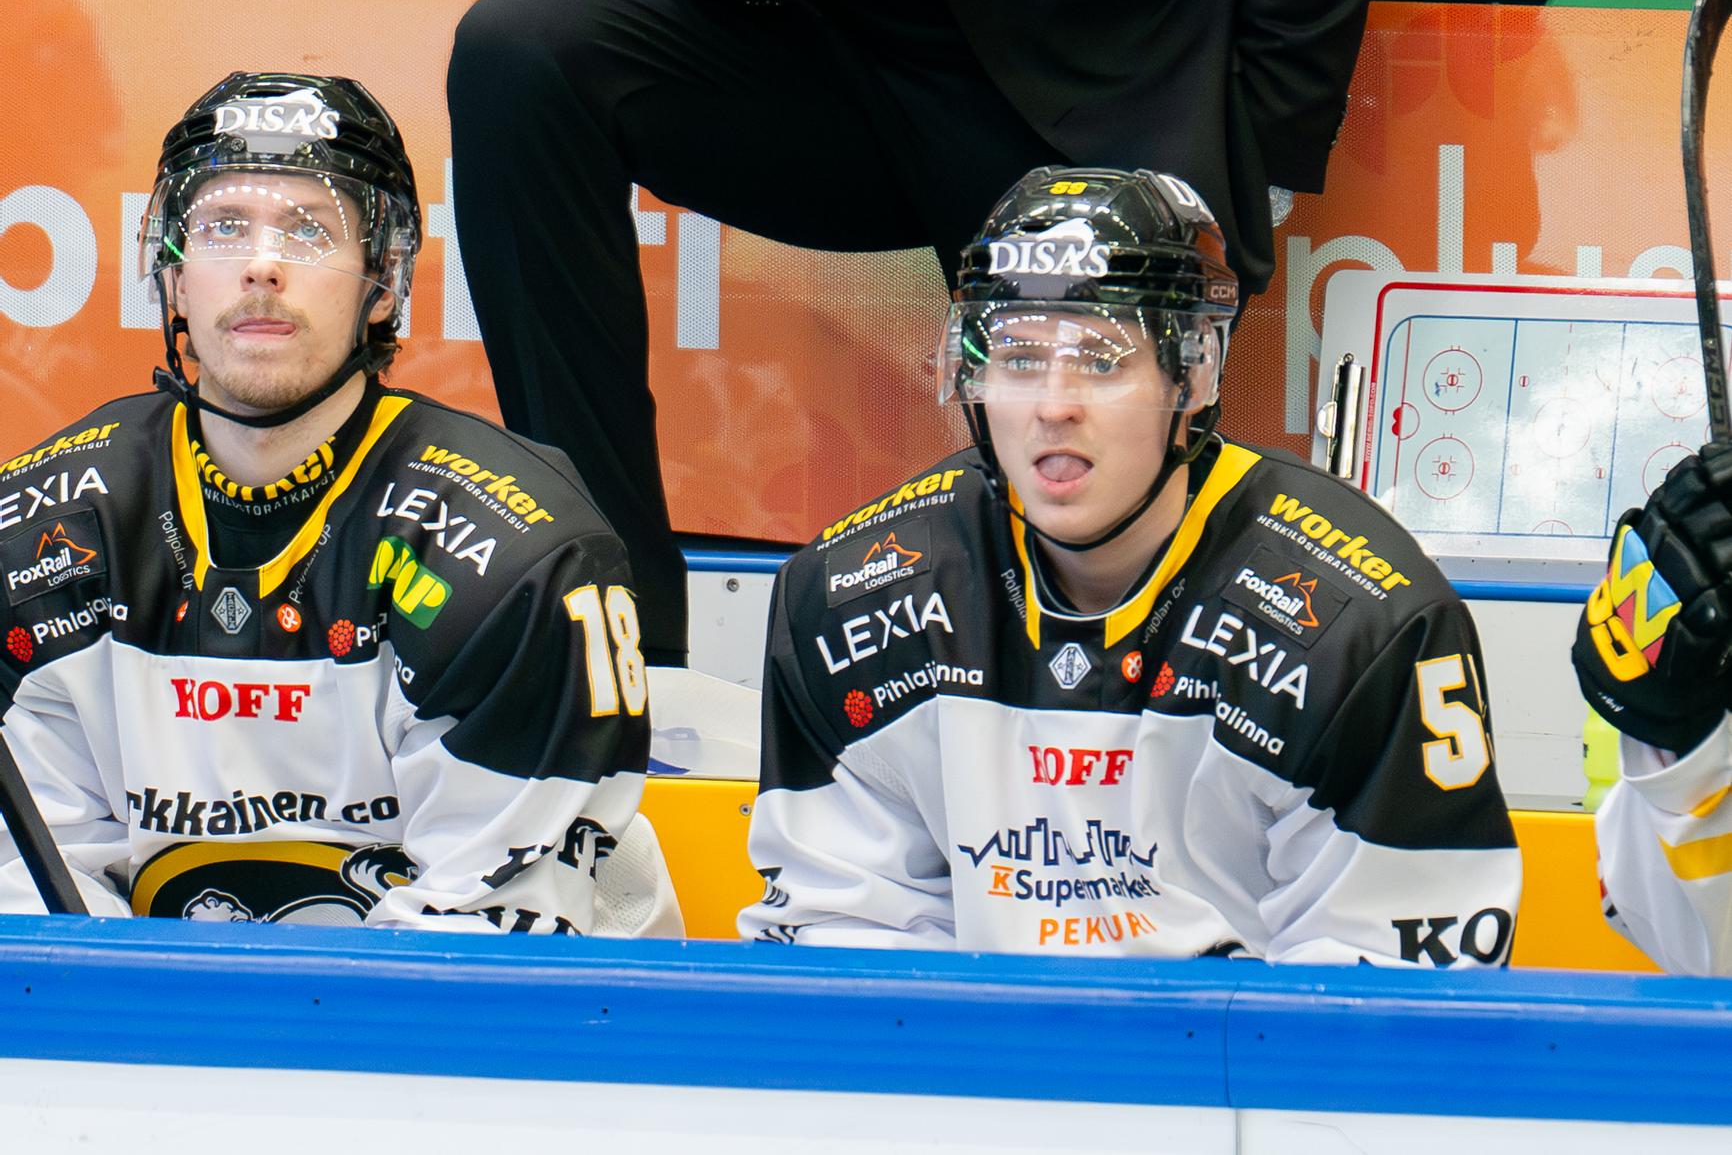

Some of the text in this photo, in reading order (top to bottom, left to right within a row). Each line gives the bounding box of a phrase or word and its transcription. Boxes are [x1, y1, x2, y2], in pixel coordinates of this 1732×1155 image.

[214, 103, 340, 140] DISAS
[988, 241, 1111, 278] DISAS
[1211, 286, 1236, 299] CCM
[420, 445, 555, 525] worker
[823, 469, 964, 541] worker
[377, 482, 497, 577] LEXIA
[1269, 493, 1412, 591] worker
[7, 547, 72, 591] FoxRail
[830, 551, 898, 592] FoxRail
[865, 566, 914, 590] LOGISTICS
[1235, 568, 1305, 617] FoxRail
[816, 592, 954, 675] LEXIA
[1258, 601, 1305, 636] LOGISTICS
[563, 584, 648, 717] 18
[1181, 605, 1310, 710] LEXIA
[171, 678, 311, 722] KOFF
[1415, 653, 1495, 792] 5
[1039, 911, 1158, 945] PEKURI
